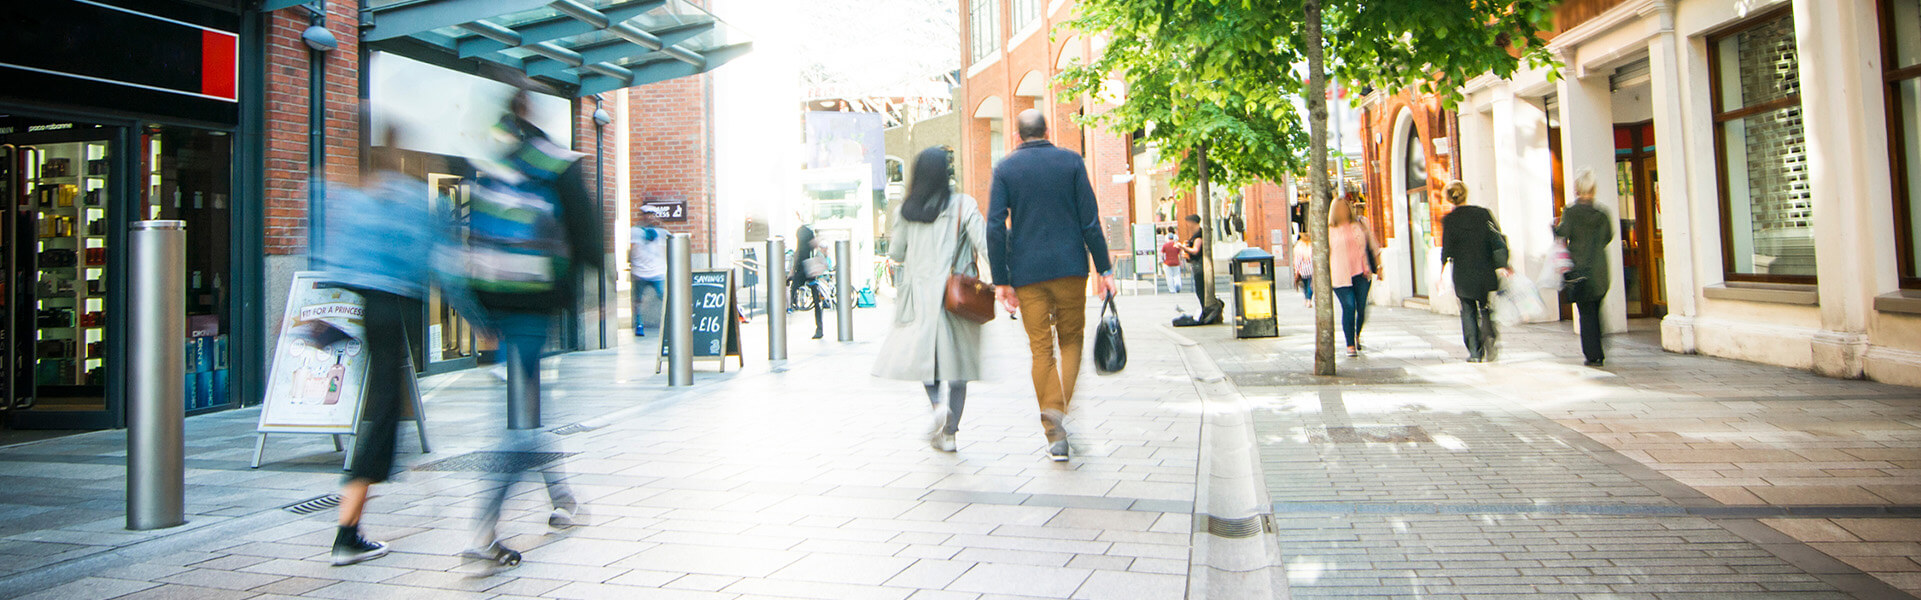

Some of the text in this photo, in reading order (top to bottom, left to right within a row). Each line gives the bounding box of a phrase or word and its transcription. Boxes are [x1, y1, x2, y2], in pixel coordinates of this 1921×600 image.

[694, 275, 724, 283] SAVINGS
[703, 292, 725, 308] £20
[313, 307, 326, 315] FOR
[335, 305, 365, 317] PRINCESS
[699, 316, 720, 332] £16
